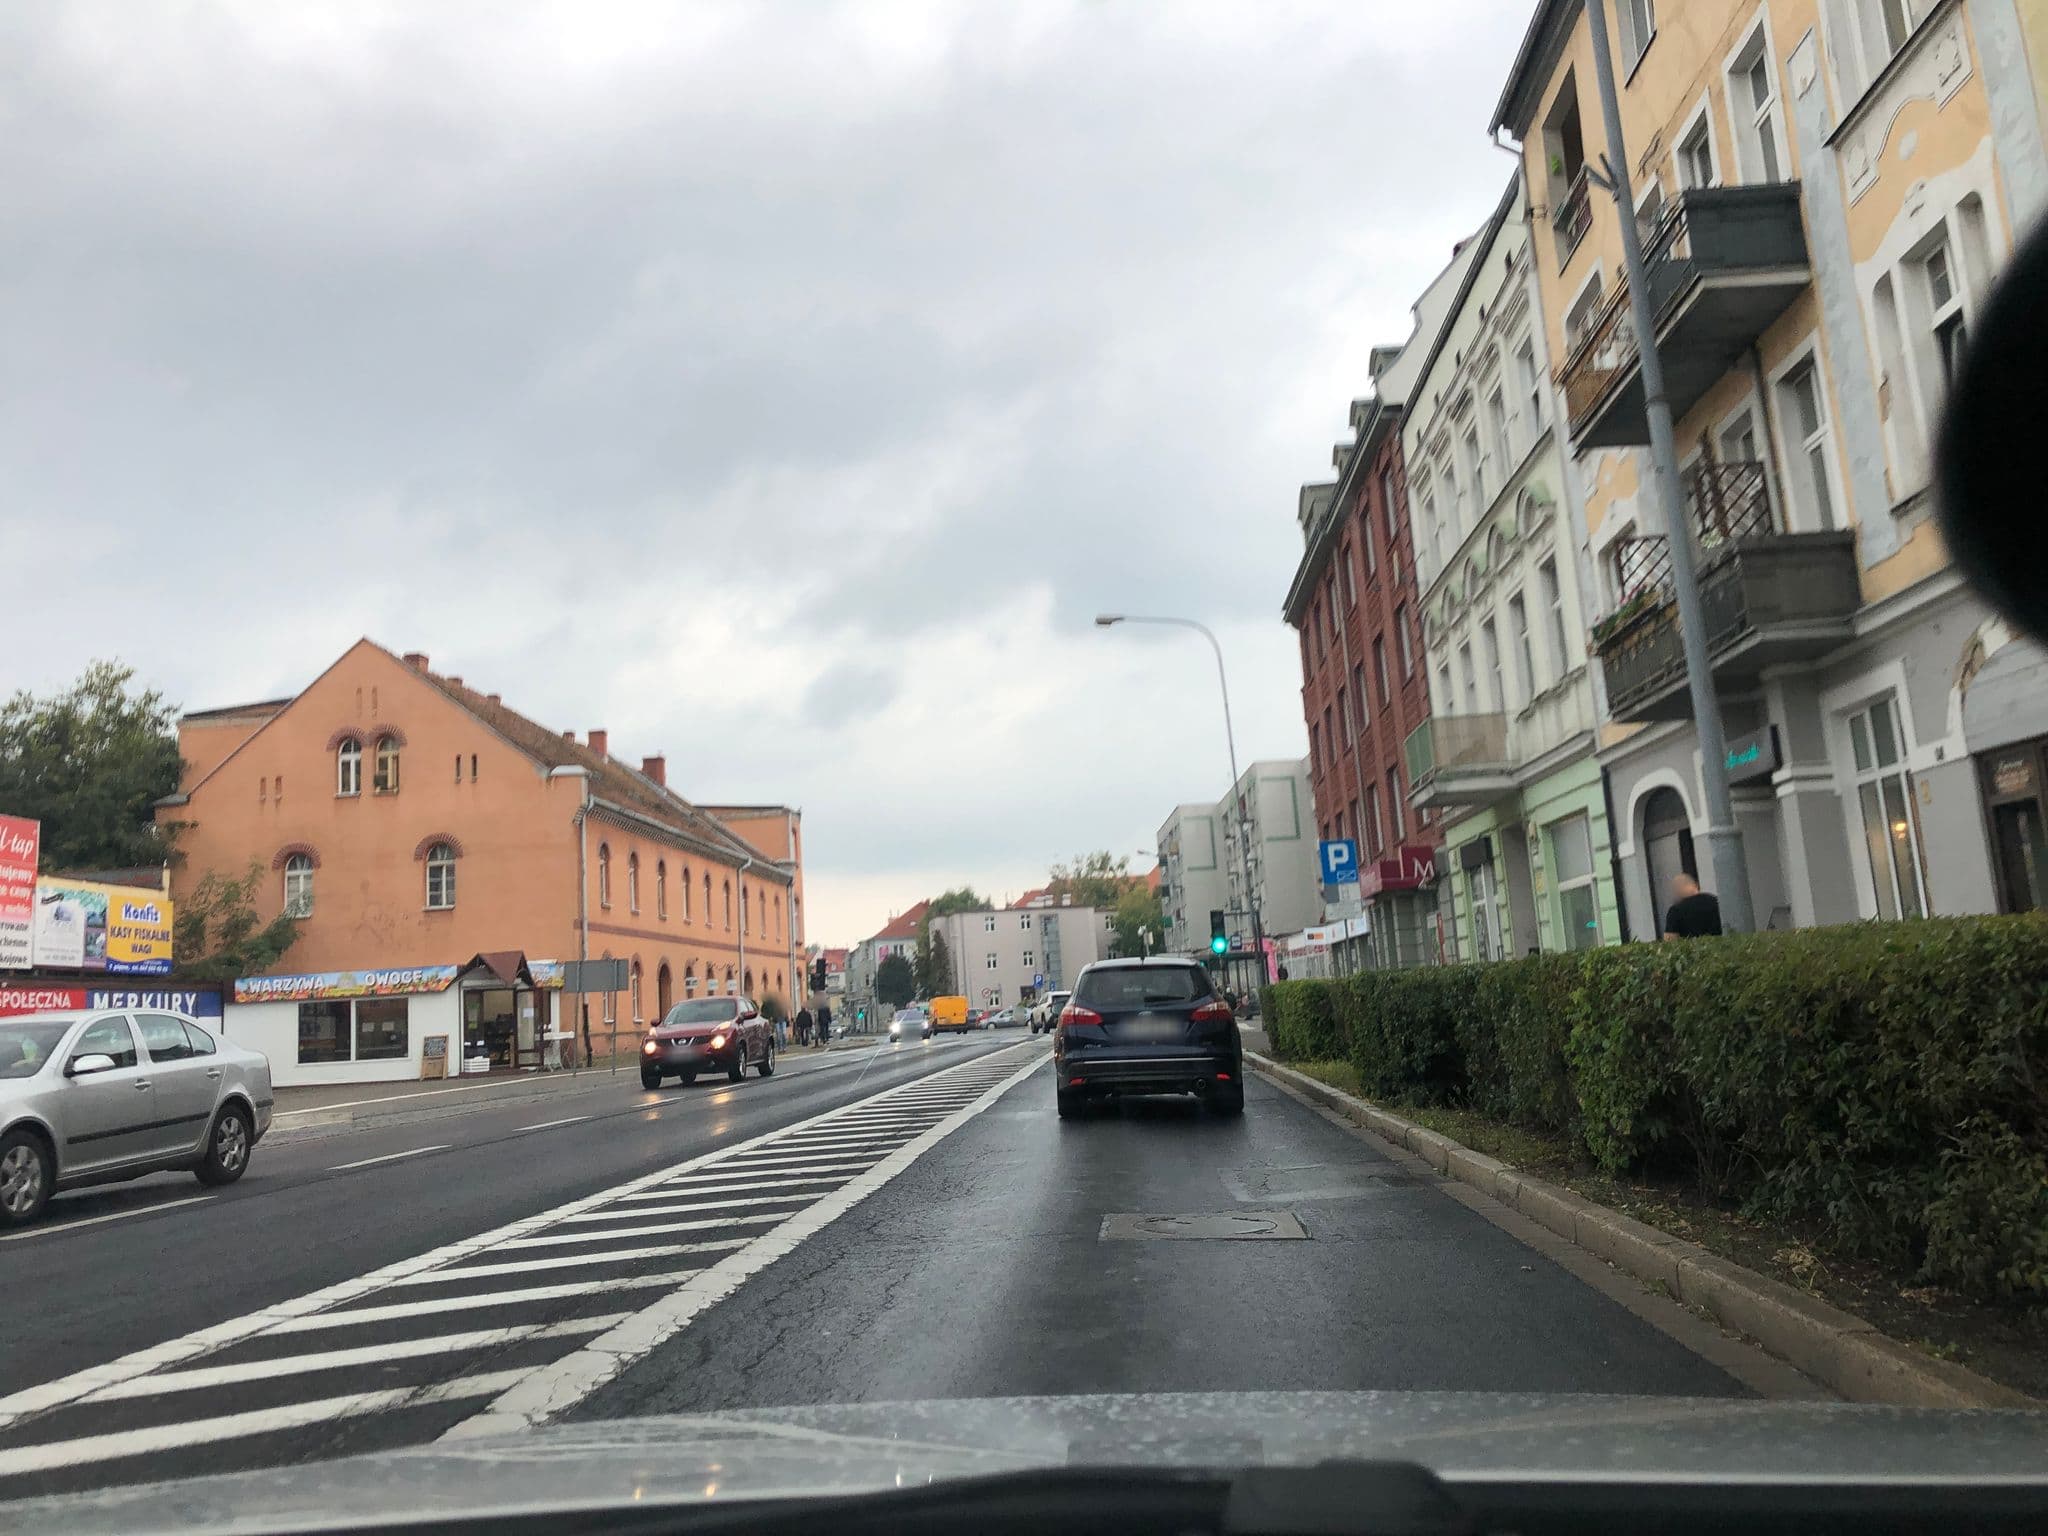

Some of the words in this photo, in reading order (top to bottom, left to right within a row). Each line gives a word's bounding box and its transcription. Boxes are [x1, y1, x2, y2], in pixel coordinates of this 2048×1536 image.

[1328, 843, 1349, 872] P
[124, 903, 159, 922] Konfis
[111, 925, 131, 938] KASY
[135, 928, 170, 942] FISKALNE
[132, 943, 152, 954] WAGI
[249, 975, 324, 994] WARZYWA
[365, 969, 423, 986] OWOCE
[0, 991, 71, 1009] POŁECZNA
[93, 992, 197, 1015] MERKURY
